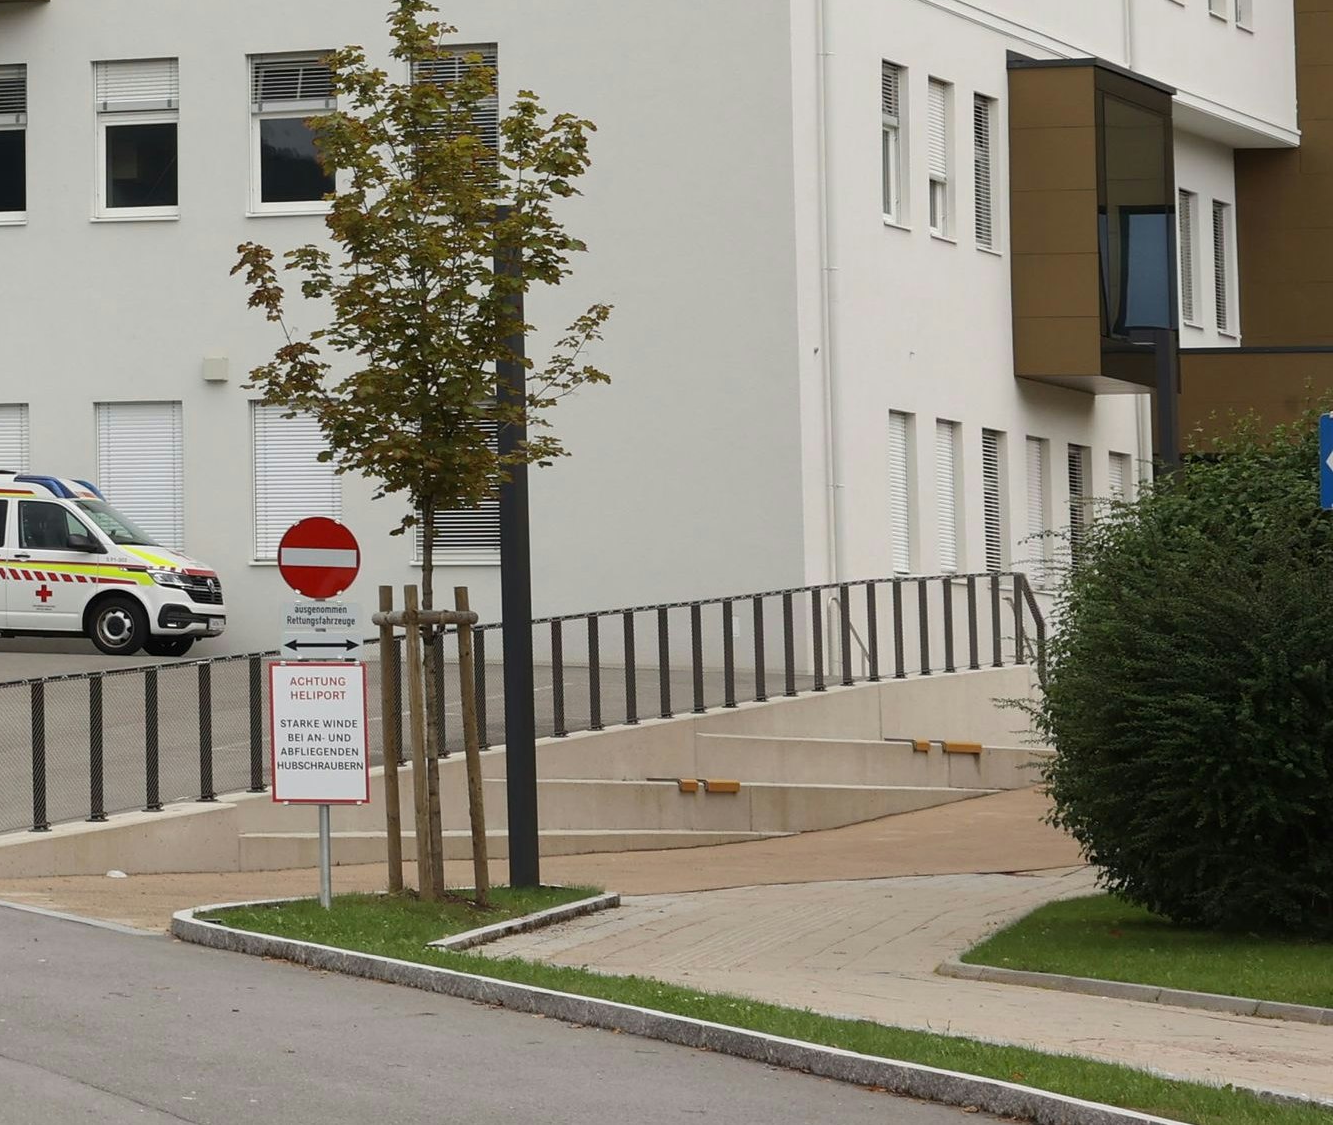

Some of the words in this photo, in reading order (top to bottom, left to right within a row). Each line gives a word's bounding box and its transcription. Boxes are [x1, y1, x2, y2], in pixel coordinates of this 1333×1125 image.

[294, 605, 348, 616] ausgenommen
[286, 615, 356, 627] Rettungsfahrzeuge
[289, 676, 347, 687] ACHTUNG
[290, 690, 347, 701] HELIPORT
[279, 719, 320, 729] STARKE
[322, 719, 358, 728] WINDE
[287, 733, 304, 743] BEI
[306, 733, 325, 743] AN-
[328, 733, 351, 743] UND
[280, 747, 359, 757] ABFLIEGENDEN
[276, 760, 364, 771] HUBSCHRAUBERN
